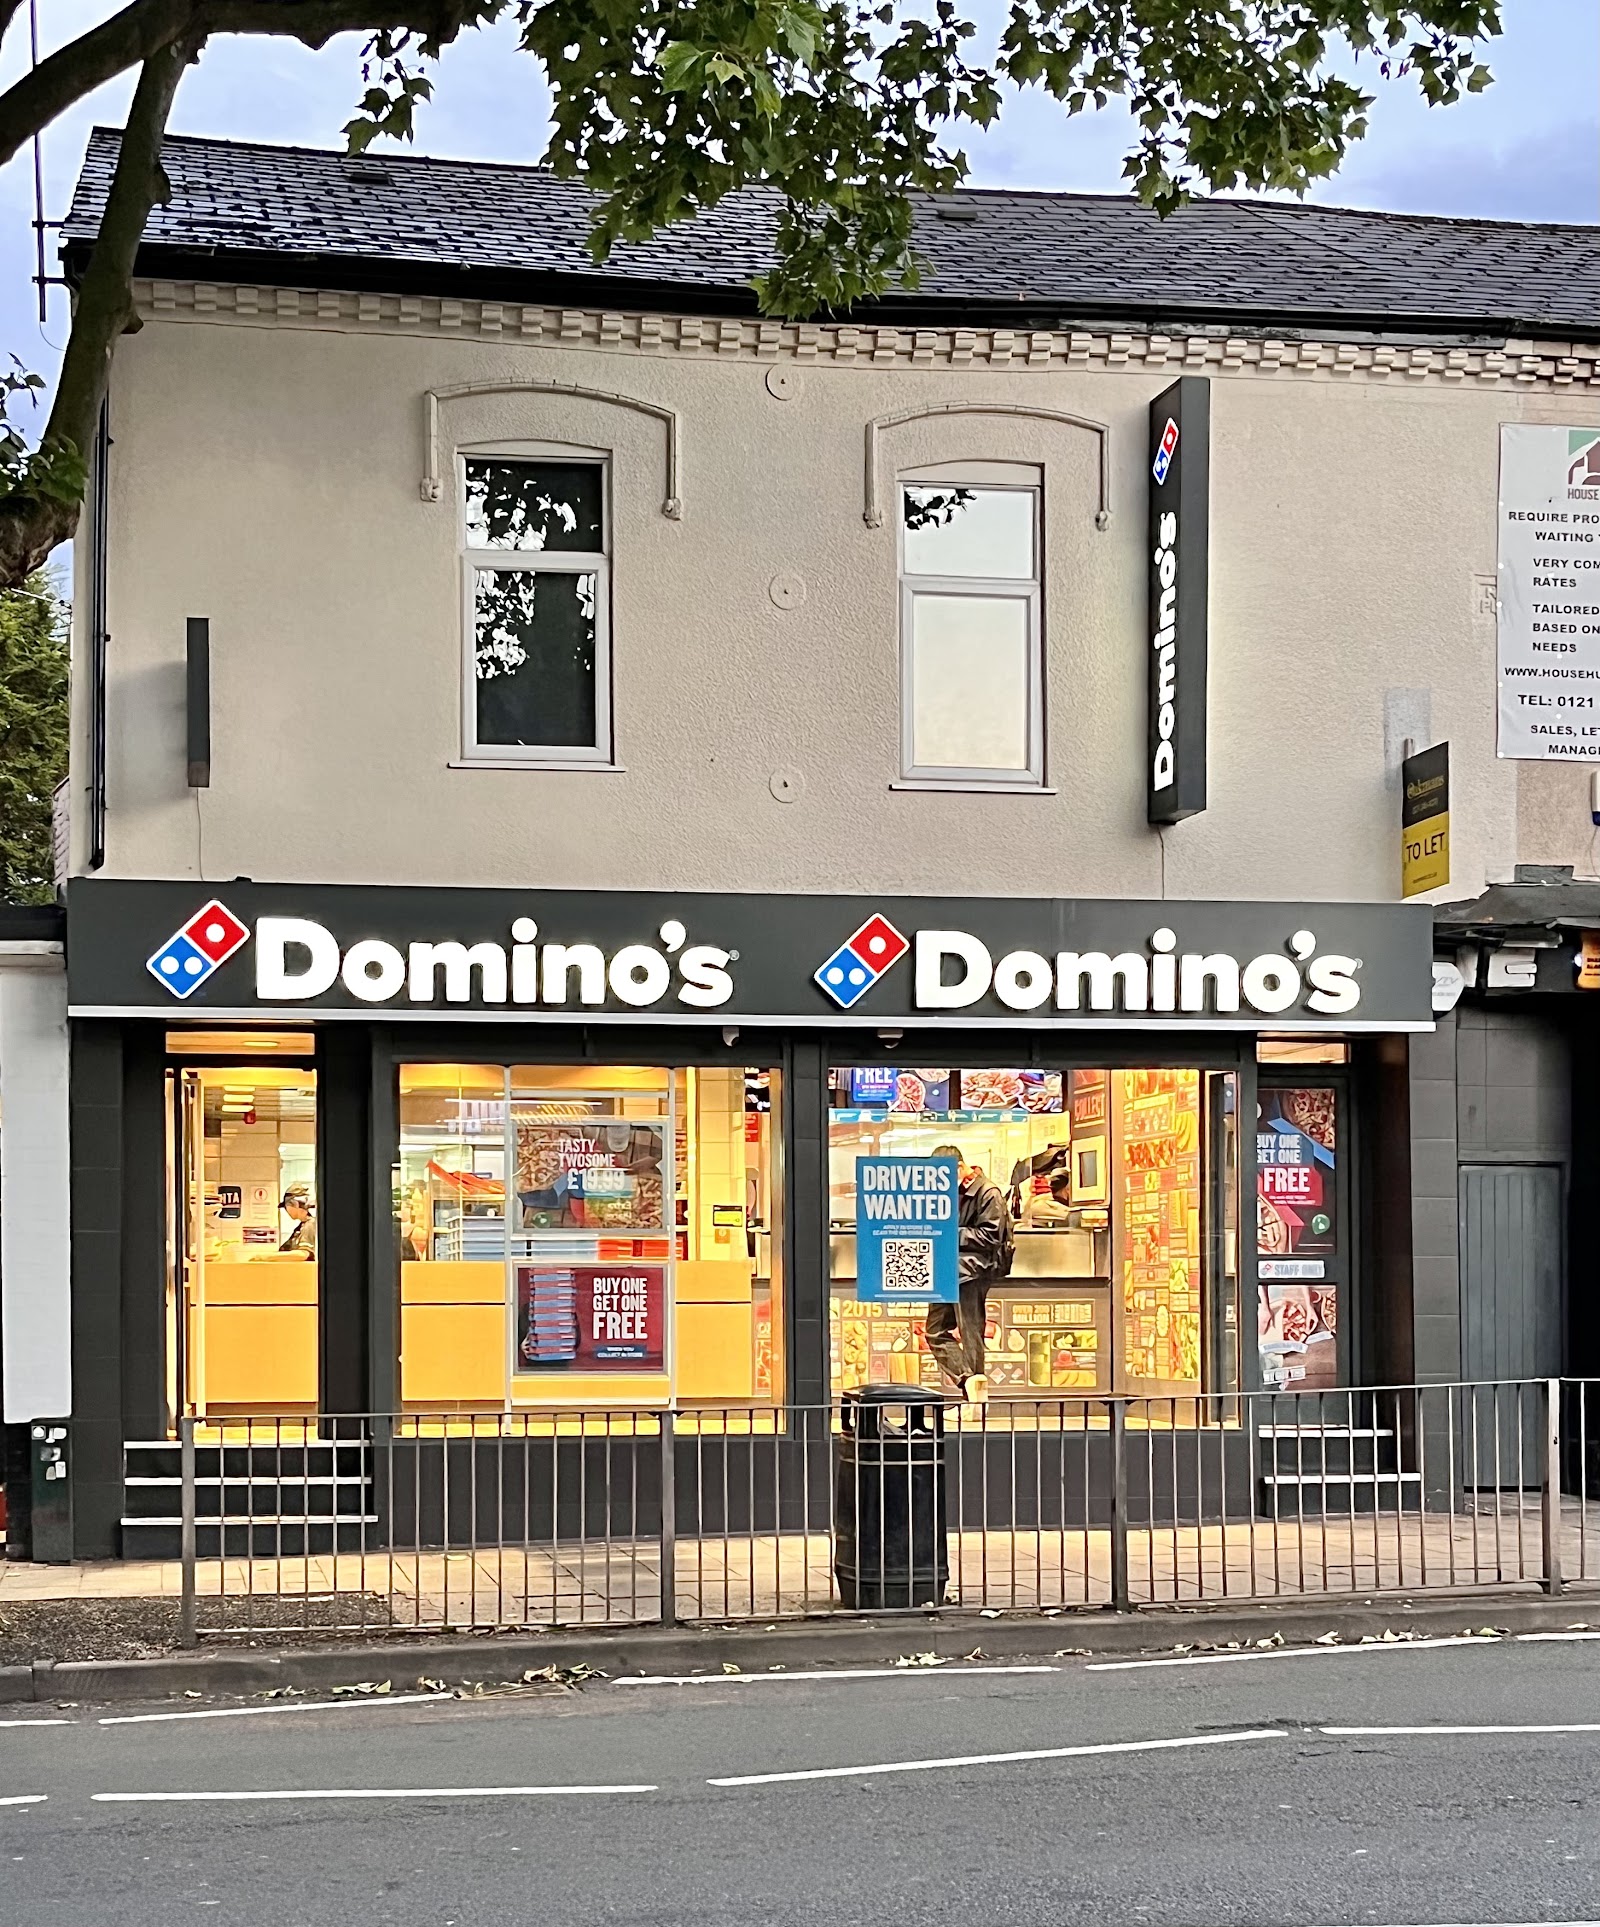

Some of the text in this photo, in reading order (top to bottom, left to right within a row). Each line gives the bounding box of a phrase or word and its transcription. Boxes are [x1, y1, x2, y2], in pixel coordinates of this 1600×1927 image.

[1567, 488, 1600, 500] HOUSE
[1508, 511, 1600, 524] REQUIRE PRO
[1535, 531, 1594, 543] WAITING
[1533, 558, 1569, 568] VERY
[1533, 577, 1576, 587] RATES
[1532, 604, 1600, 615] TAILORED
[1533, 623, 1600, 634] BASED ON
[1152, 511, 1177, 791] Domino's
[1533, 642, 1577, 652] NEEDS
[1518, 694, 1594, 708] TEL: 0121
[1531, 725, 1577, 737] SALES,
[1548, 745, 1600, 755] MANAG
[1406, 832, 1446, 863] TO LET
[255, 917, 735, 1007] Domino's
[915, 927, 1361, 1015] Domino's
[855, 1067, 894, 1084] FREE
[558, 1138, 596, 1153] TASTY
[1279, 1134, 1301, 1148] ONE
[558, 1153, 616, 1168] TWOSOME
[1278, 1149, 1301, 1164] ONE
[567, 1167, 625, 1191] £19.99
[863, 1165, 951, 1191] DRIVERS
[1263, 1167, 1311, 1193] FREE
[864, 1194, 952, 1220] WANTED
[1274, 1263, 1323, 1277] STAFF ONLY
[593, 1277, 648, 1294] BUY ONE
[592, 1294, 648, 1311] GET ONE
[842, 1300, 883, 1318] 2015
[593, 1312, 648, 1340] FREE
